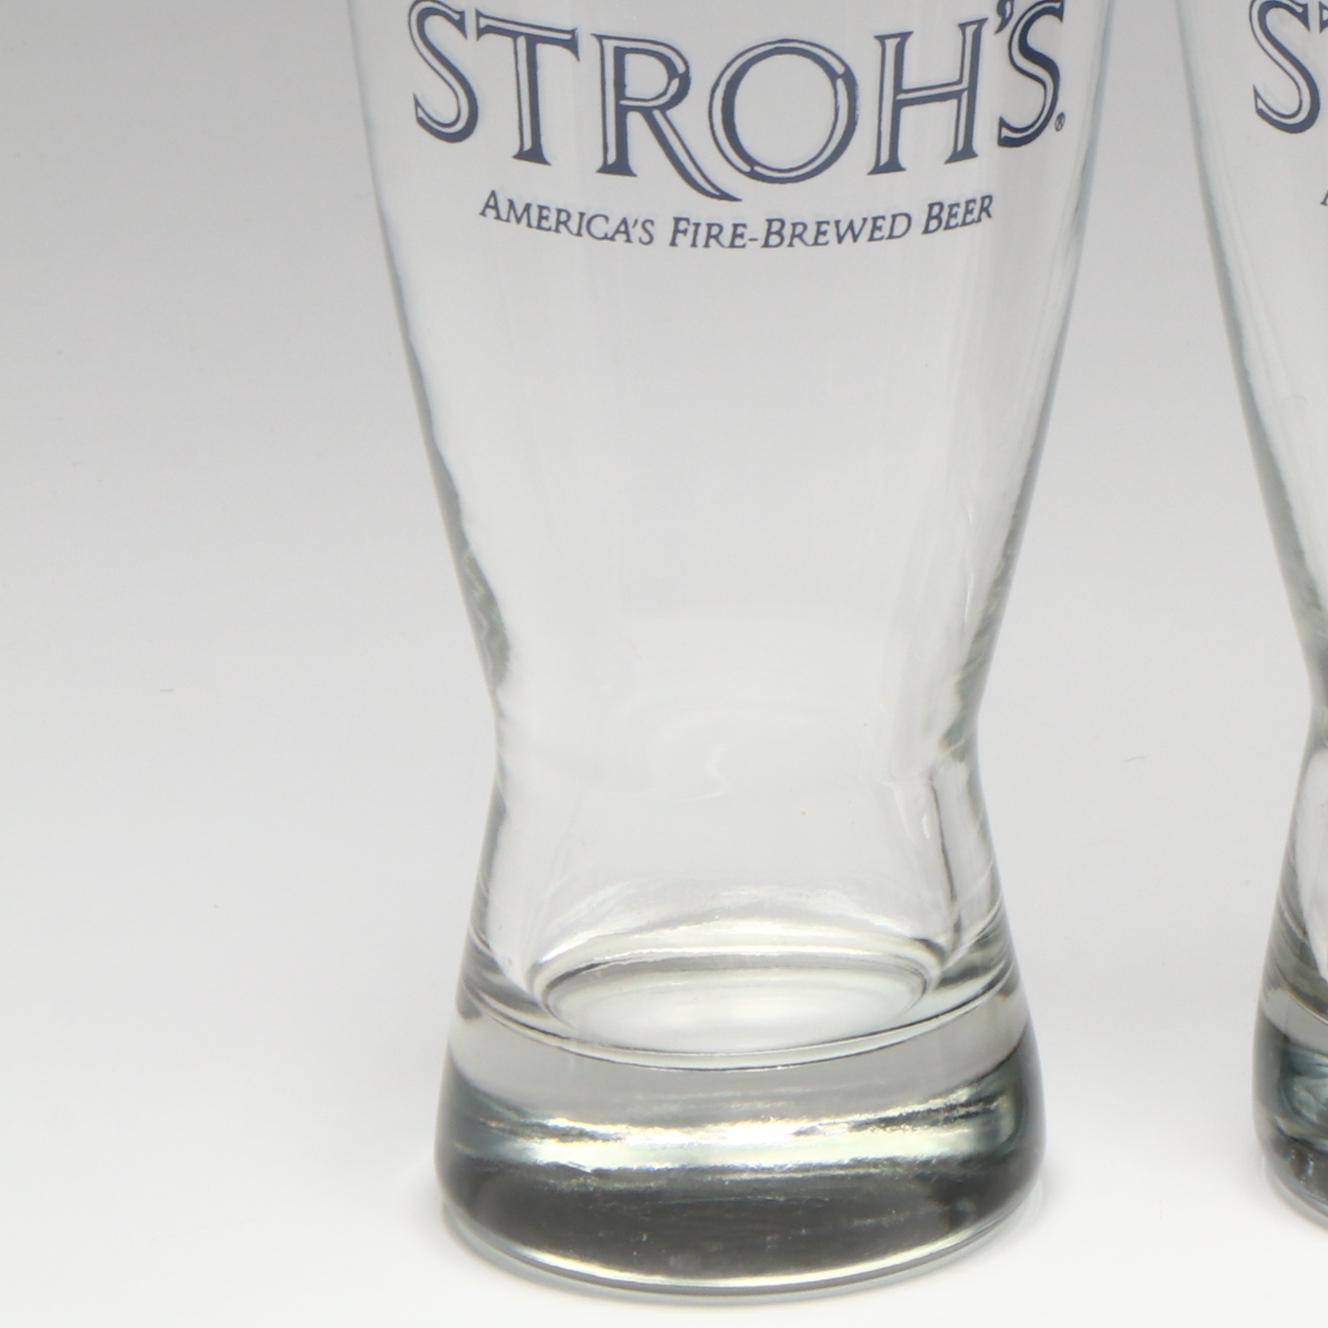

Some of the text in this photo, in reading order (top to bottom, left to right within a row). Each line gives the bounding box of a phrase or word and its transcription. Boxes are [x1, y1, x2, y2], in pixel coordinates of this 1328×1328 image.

[479, 188, 994, 249] AMERICA'S FIRE-BREWED BEER
